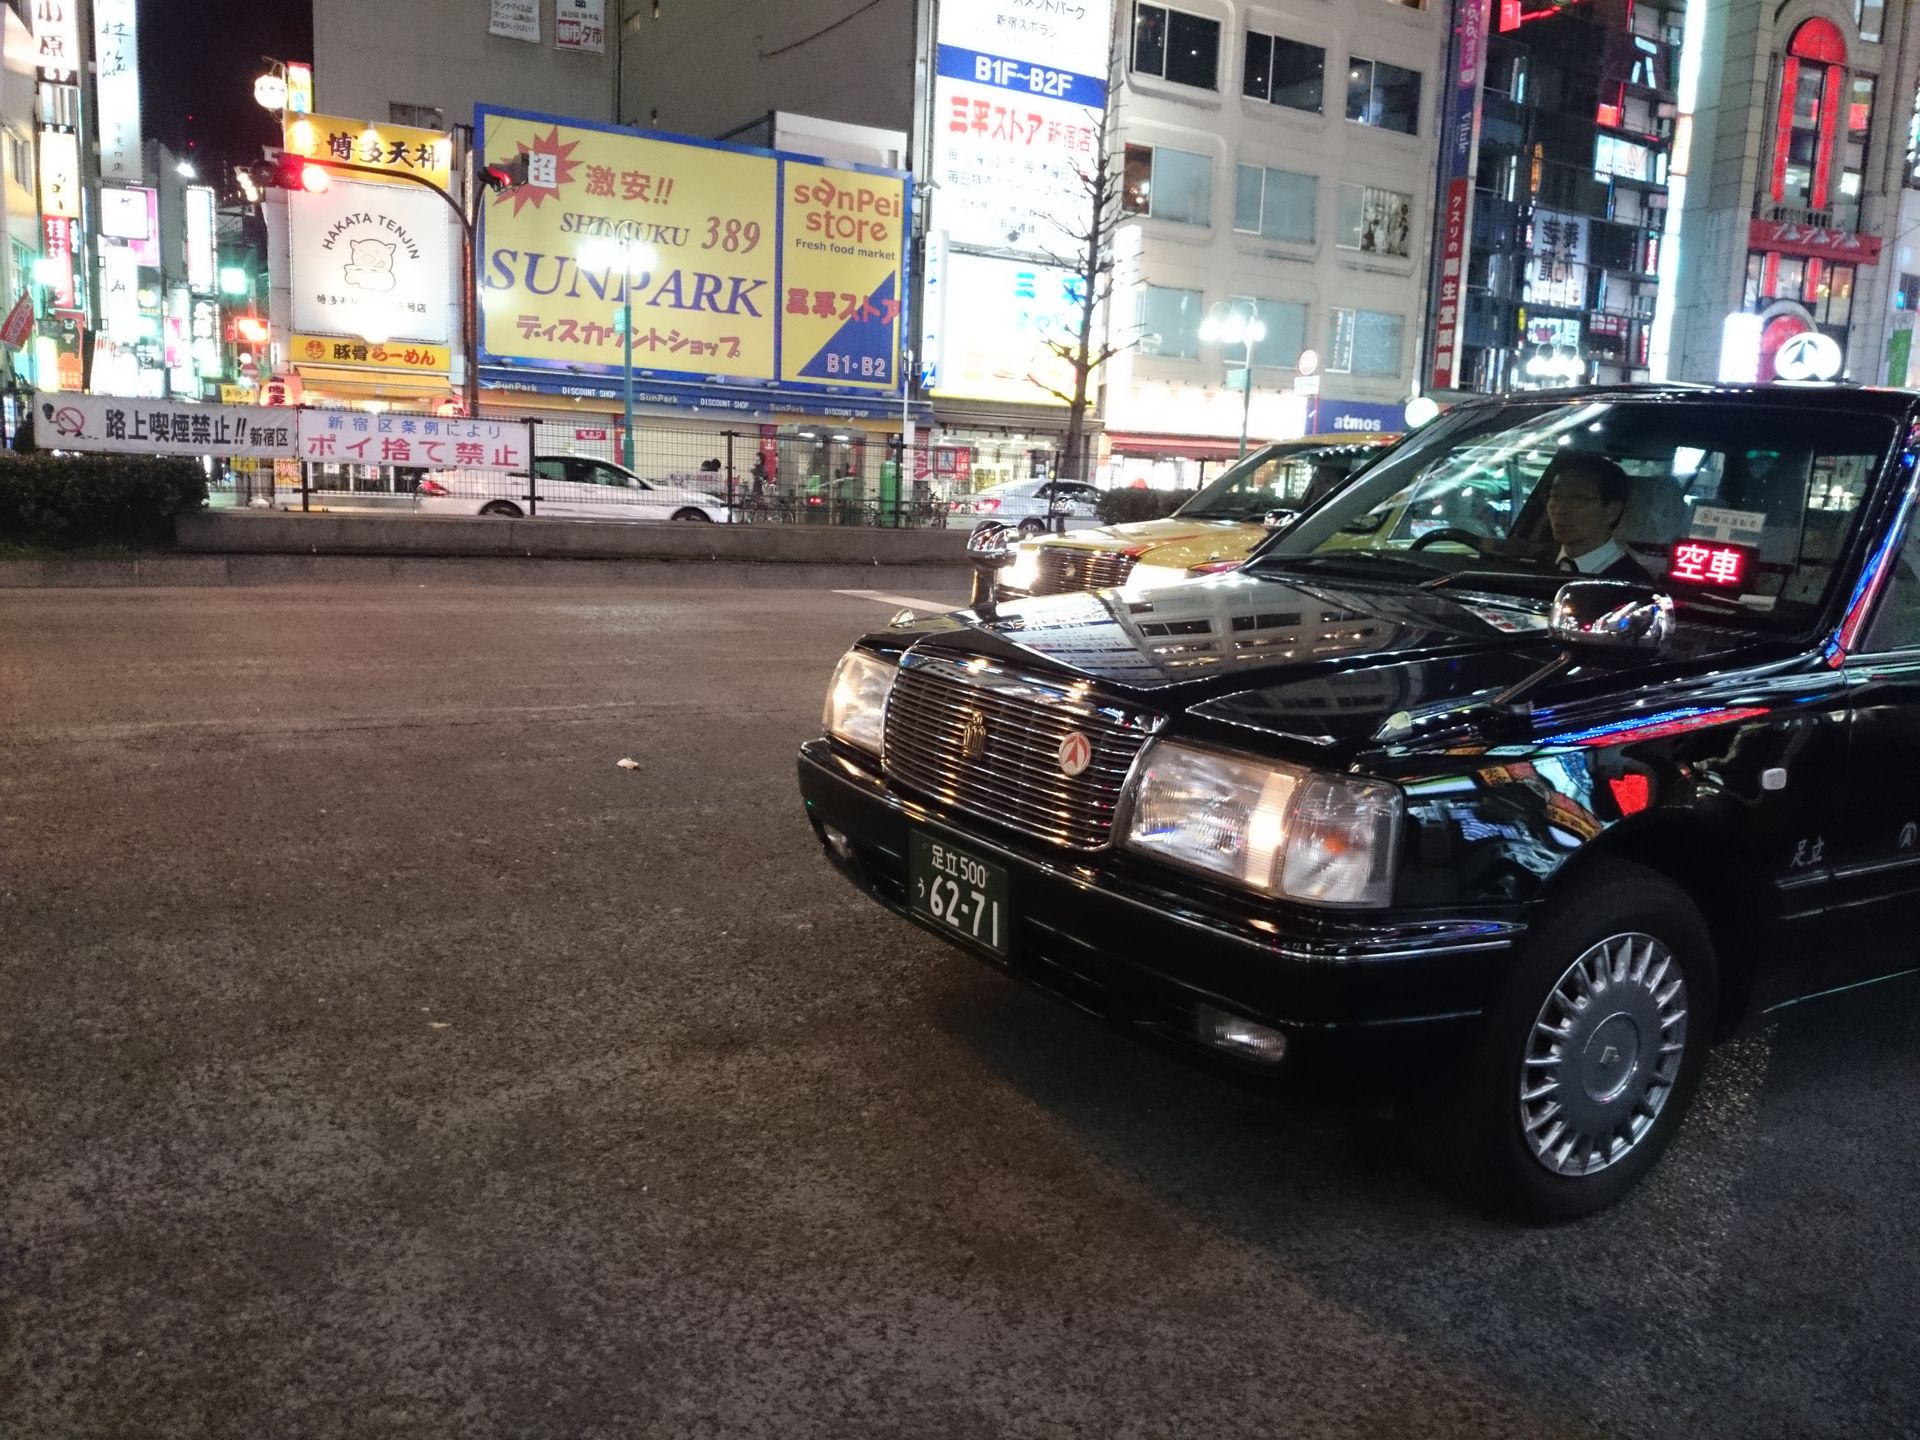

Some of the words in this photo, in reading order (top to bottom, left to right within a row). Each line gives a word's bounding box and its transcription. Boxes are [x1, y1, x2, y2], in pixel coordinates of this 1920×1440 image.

[949, 96, 1043, 145] 三平ストア
[326, 131, 441, 172] 博多天神
[528, 150, 557, 188] 超
[322, 212, 372, 251] HAKATA
[378, 214, 420, 260] TENJIN
[701, 216, 761, 254] 389
[806, 210, 888, 243] store
[795, 238, 827, 252] Fresh
[830, 243, 855, 256] food
[857, 248, 896, 261] market
[786, 287, 900, 326] 三平ストア
[333, 343, 436, 366] 豚骨らーめん
[495, 381, 538, 392] SunPark
[562, 386, 596, 398] DISCOUNT
[600, 388, 617, 399] SHOP
[639, 392, 679, 404] SunPark
[700, 398, 731, 408] DISCOUNT
[734, 399, 749, 409] SHOP
[769, 403, 806, 413] SunPark
[825, 407, 852, 417] DISCOUNT
[855, 409, 869, 417] SHOP
[327, 415, 502, 439] 新宿区条例により
[1333, 413, 1382, 432] atmos
[250, 426, 289, 448] 新宿区
[307, 433, 520, 467] ポイ捨て禁止
[1671, 544, 1740, 583] 空車
[931, 844, 958, 877] 足立
[960, 856, 986, 888] 500
[930, 875, 998, 947] 62-71
